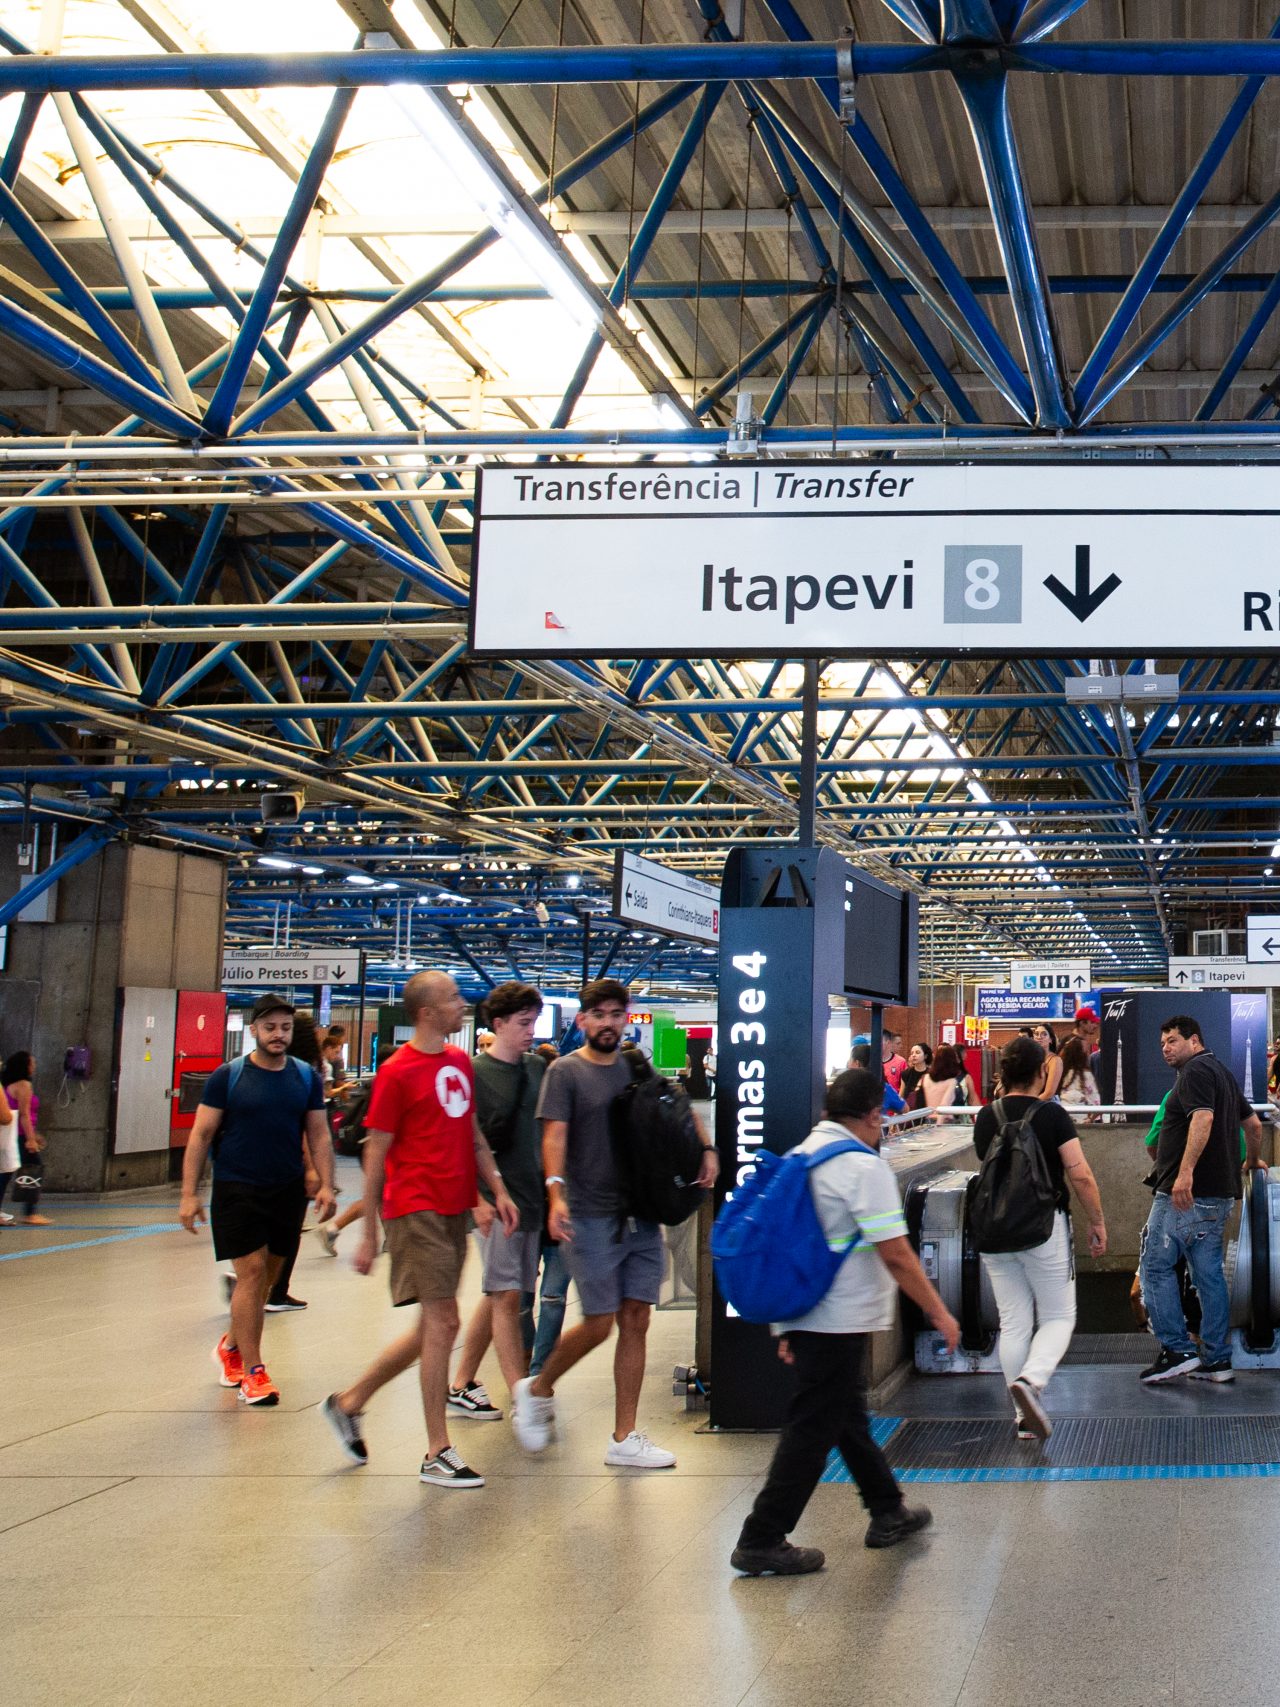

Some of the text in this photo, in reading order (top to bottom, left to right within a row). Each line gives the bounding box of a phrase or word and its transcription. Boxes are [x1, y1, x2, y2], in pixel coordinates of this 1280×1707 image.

[513, 471, 914, 502] Transferência Transfer
[701, 560, 914, 624] Itapevi
[964, 559, 1001, 610] 8
[231, 951, 310, 959] Embarque Boarding
[733, 951, 766, 977] 4
[222, 966, 308, 980] Júlio Prestes
[316, 966, 325, 978] 8
[1194, 971, 1203, 981] 8
[1209, 971, 1245, 983] Itapevi
[739, 988, 766, 1013] e
[731, 1021, 766, 1045] 3
